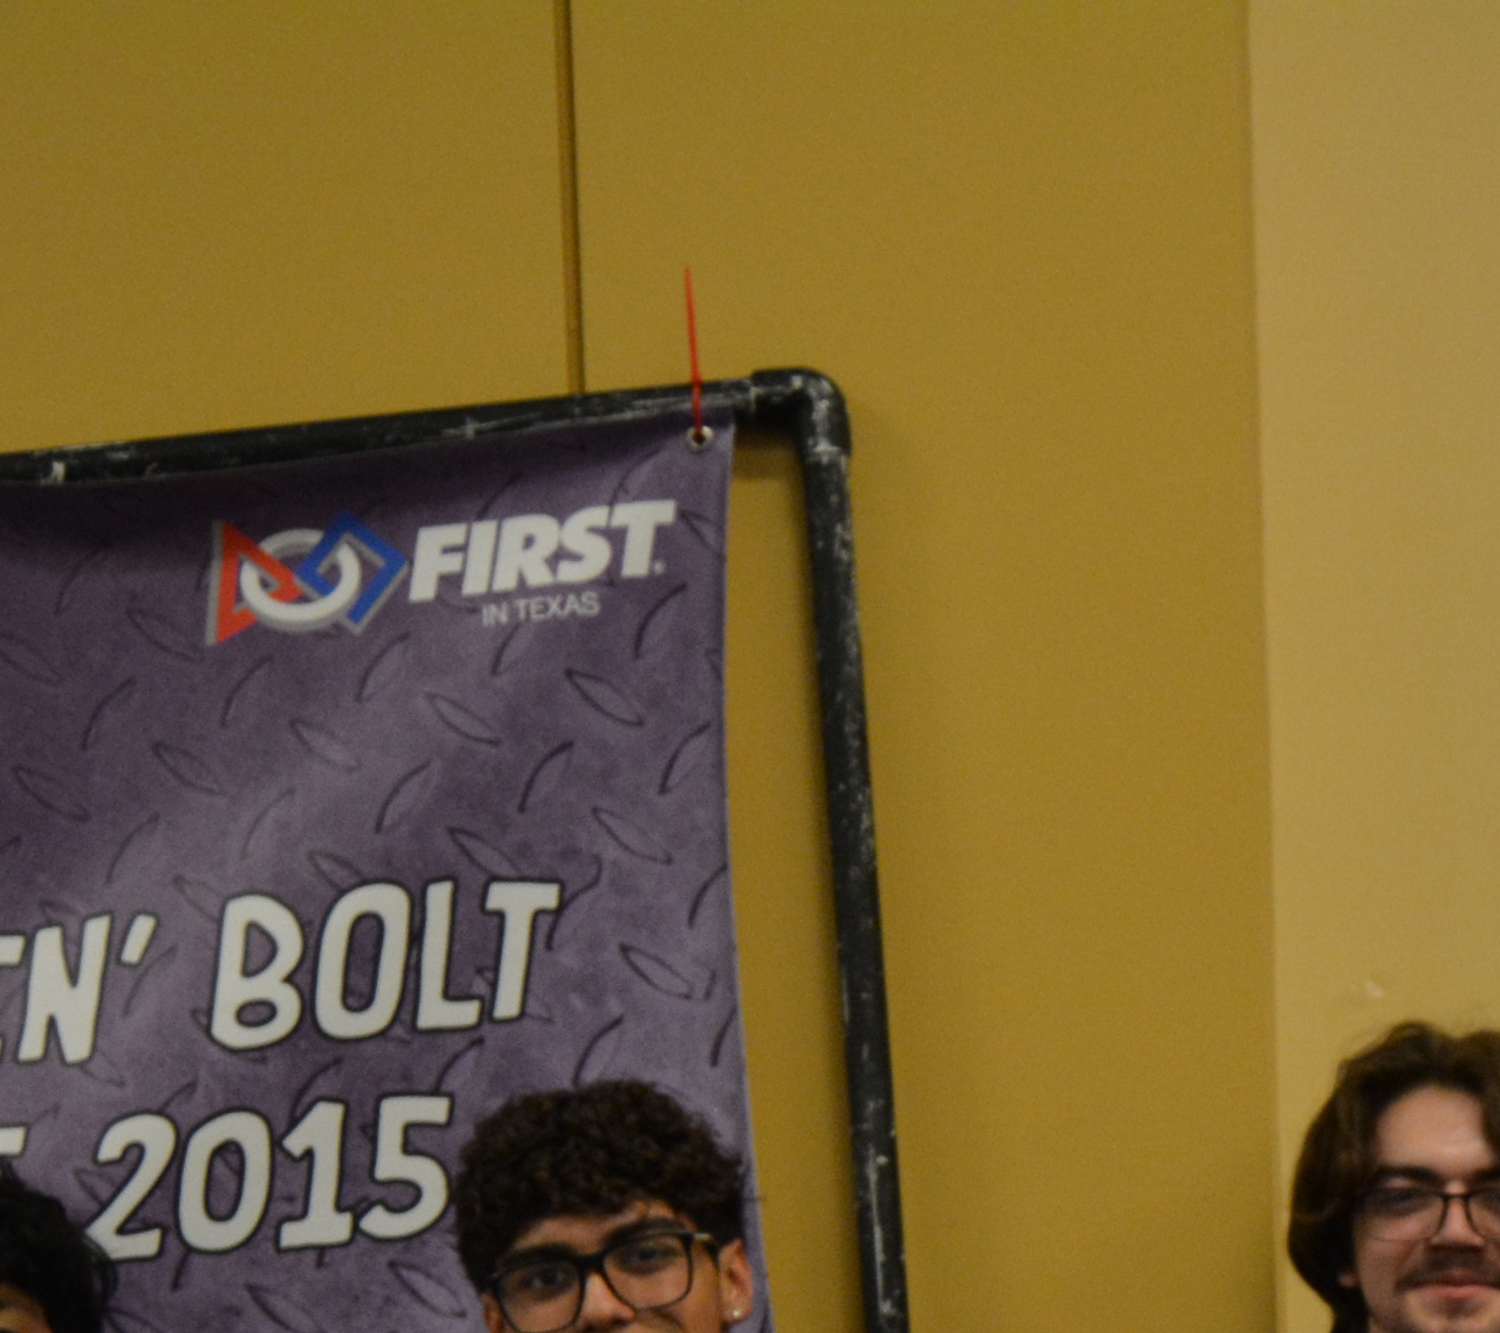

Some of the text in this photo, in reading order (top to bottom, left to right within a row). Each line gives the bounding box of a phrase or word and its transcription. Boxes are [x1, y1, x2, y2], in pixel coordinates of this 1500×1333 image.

[409, 500, 676, 604] FIRST
[482, 591, 601, 627] IN TEXAS
[209, 877, 562, 1052] BOLT
[87, 1093, 455, 1262] 2015
